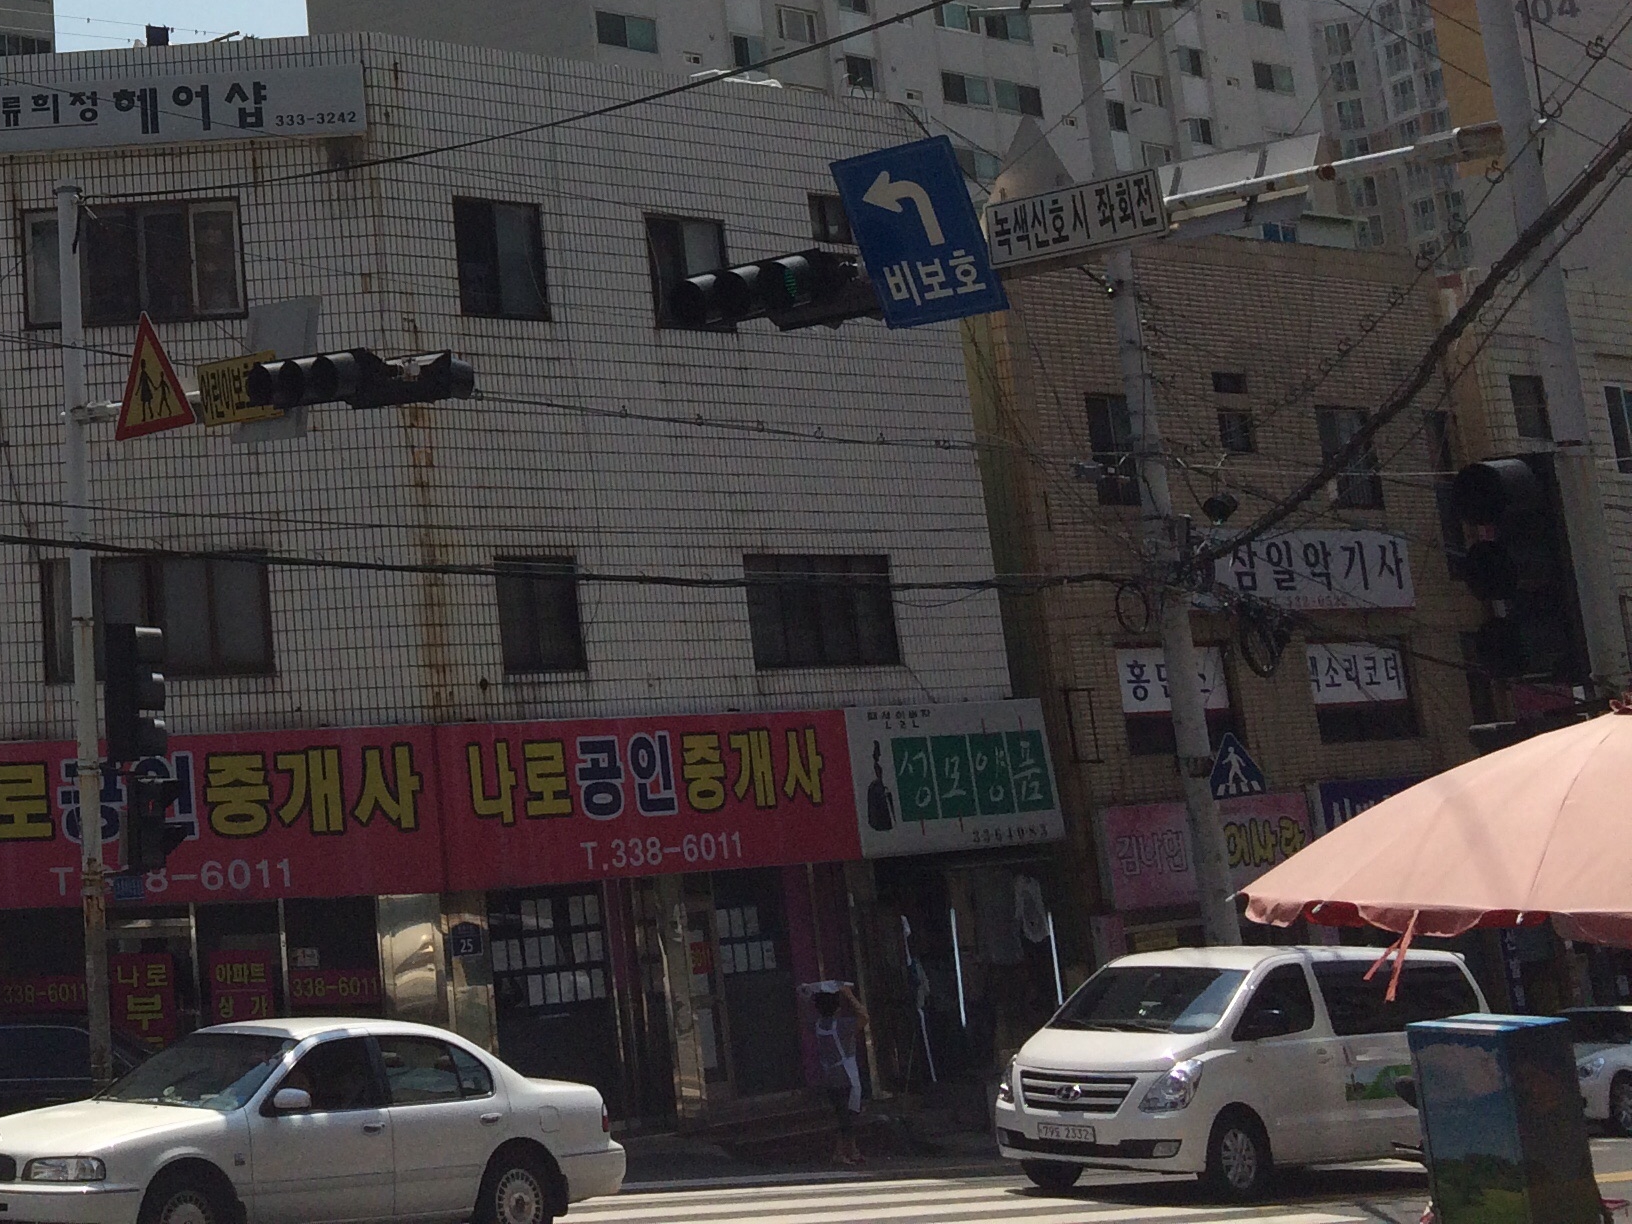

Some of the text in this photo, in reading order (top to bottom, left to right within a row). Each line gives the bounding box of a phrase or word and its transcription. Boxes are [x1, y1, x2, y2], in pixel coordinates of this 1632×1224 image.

[1, 80, 357, 135] 류희정 헤어샵 333-3242
[994, 173, 1159, 255] 녹색신호시 좌회전
[882, 249, 986, 307] 비보호
[1230, 540, 1404, 592] 삼일악기사
[579, 830, 743, 872] T.338-6011
[49, 855, 293, 894] T8-6011
[460, 938, 474, 953] 25
[116, 963, 168, 989] 나로
[215, 962, 268, 984] 아파트
[292, 976, 378, 997] 338-6011
[2, 982, 87, 1007] 338-6011
[218, 994, 268, 1019] 상가
